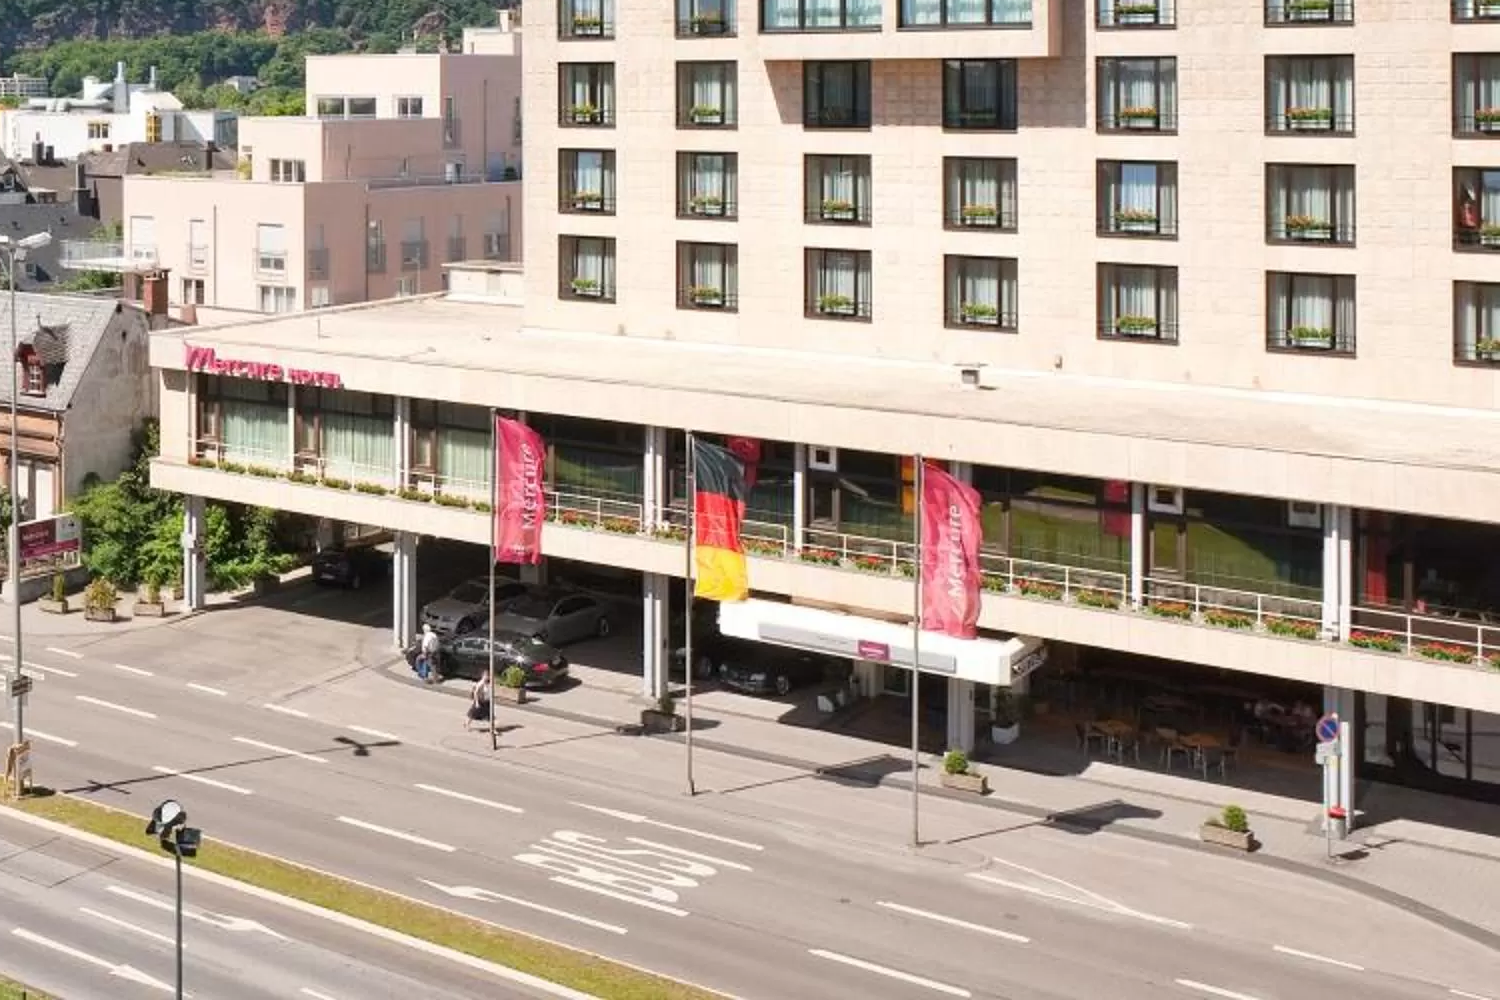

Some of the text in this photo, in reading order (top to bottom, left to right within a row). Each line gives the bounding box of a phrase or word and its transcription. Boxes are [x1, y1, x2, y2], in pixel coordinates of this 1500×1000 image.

[185, 346, 283, 380] Mercure
[519, 442, 539, 530] Mercure
[947, 504, 965, 598] Mercure
[512, 829, 718, 903] BUS
